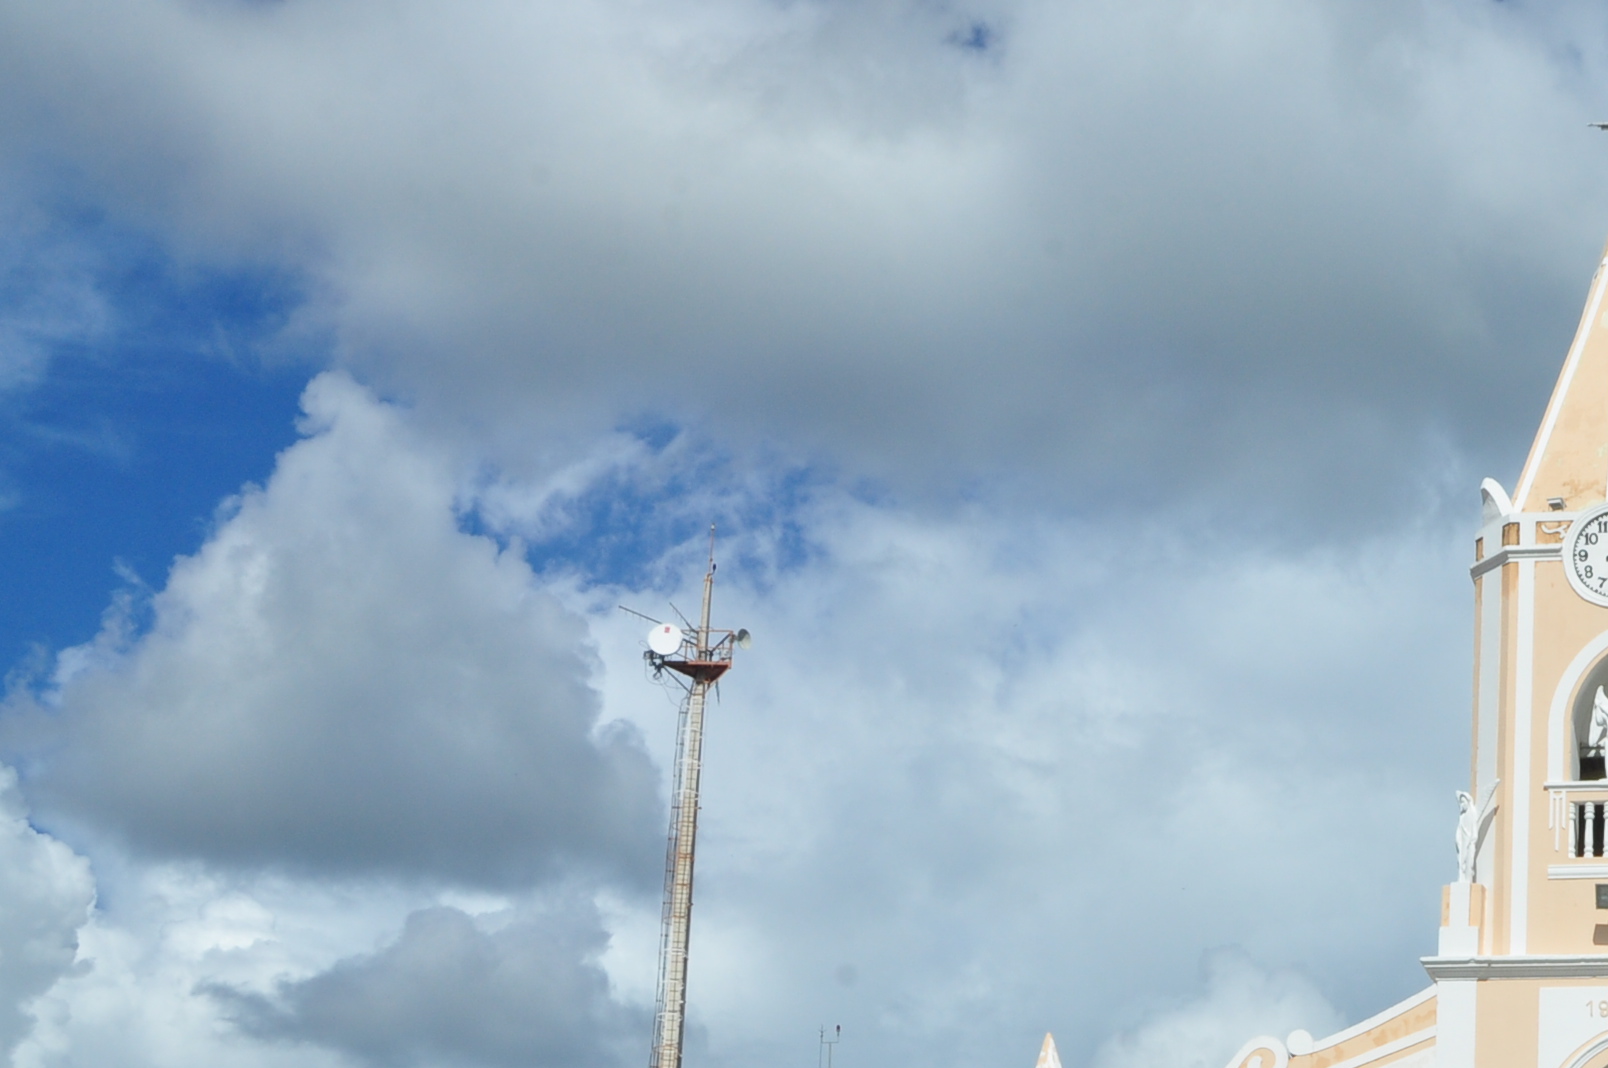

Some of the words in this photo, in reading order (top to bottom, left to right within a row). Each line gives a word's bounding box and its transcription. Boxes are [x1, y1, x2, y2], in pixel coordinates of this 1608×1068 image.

[1598, 521, 1608, 533] 11
[1585, 533, 1598, 545] 10
[1578, 549, 1588, 562] 9
[1584, 565, 1593, 579] 8
[1598, 577, 1608, 588] 7
